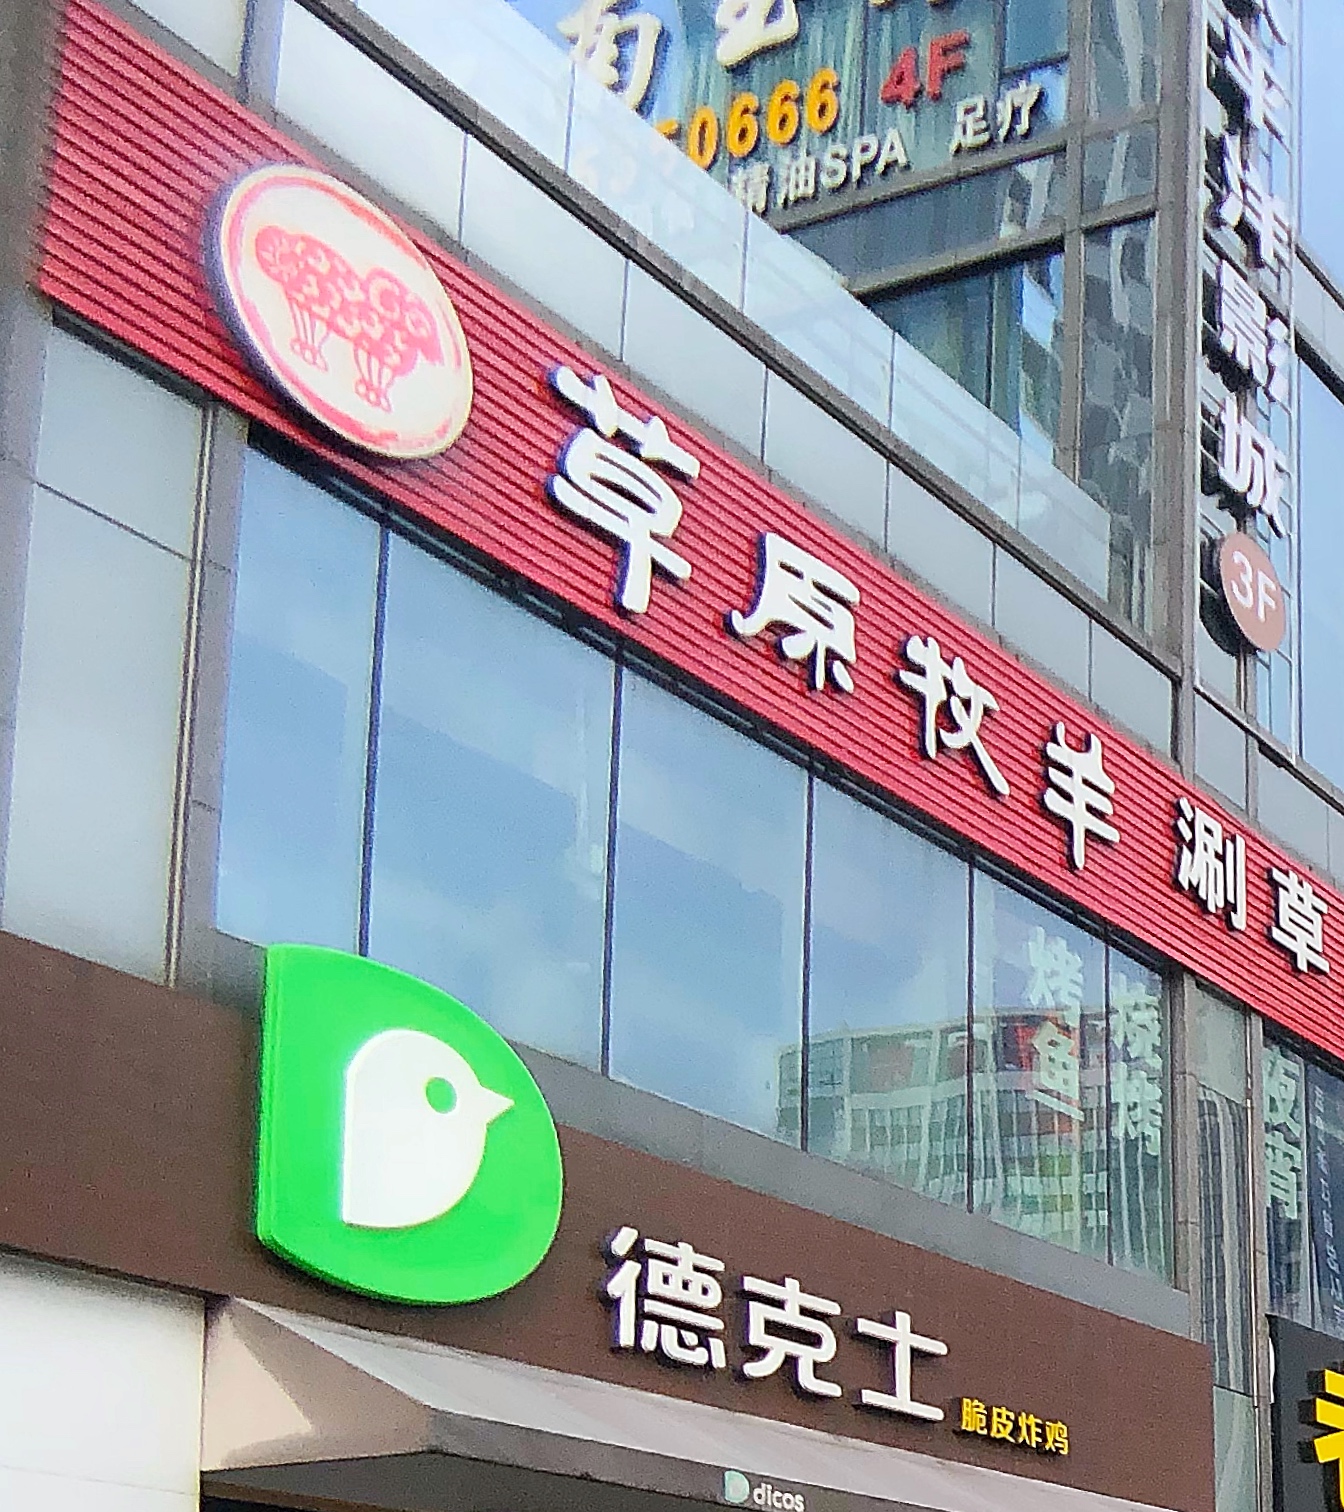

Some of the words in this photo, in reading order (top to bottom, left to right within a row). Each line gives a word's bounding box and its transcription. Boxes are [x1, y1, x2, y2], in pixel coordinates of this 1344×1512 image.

[657, 67, 840, 170] 0666
[880, 30, 969, 110] 4F
[1221, 0, 1291, 537] 平洋影城
[550, 364, 1120, 869] 草原牧羊
[1231, 555, 1278, 625] 3F
[606, 1225, 949, 1422] 德克士
[961, 1397, 1071, 1456] 脆皮炸鸡
